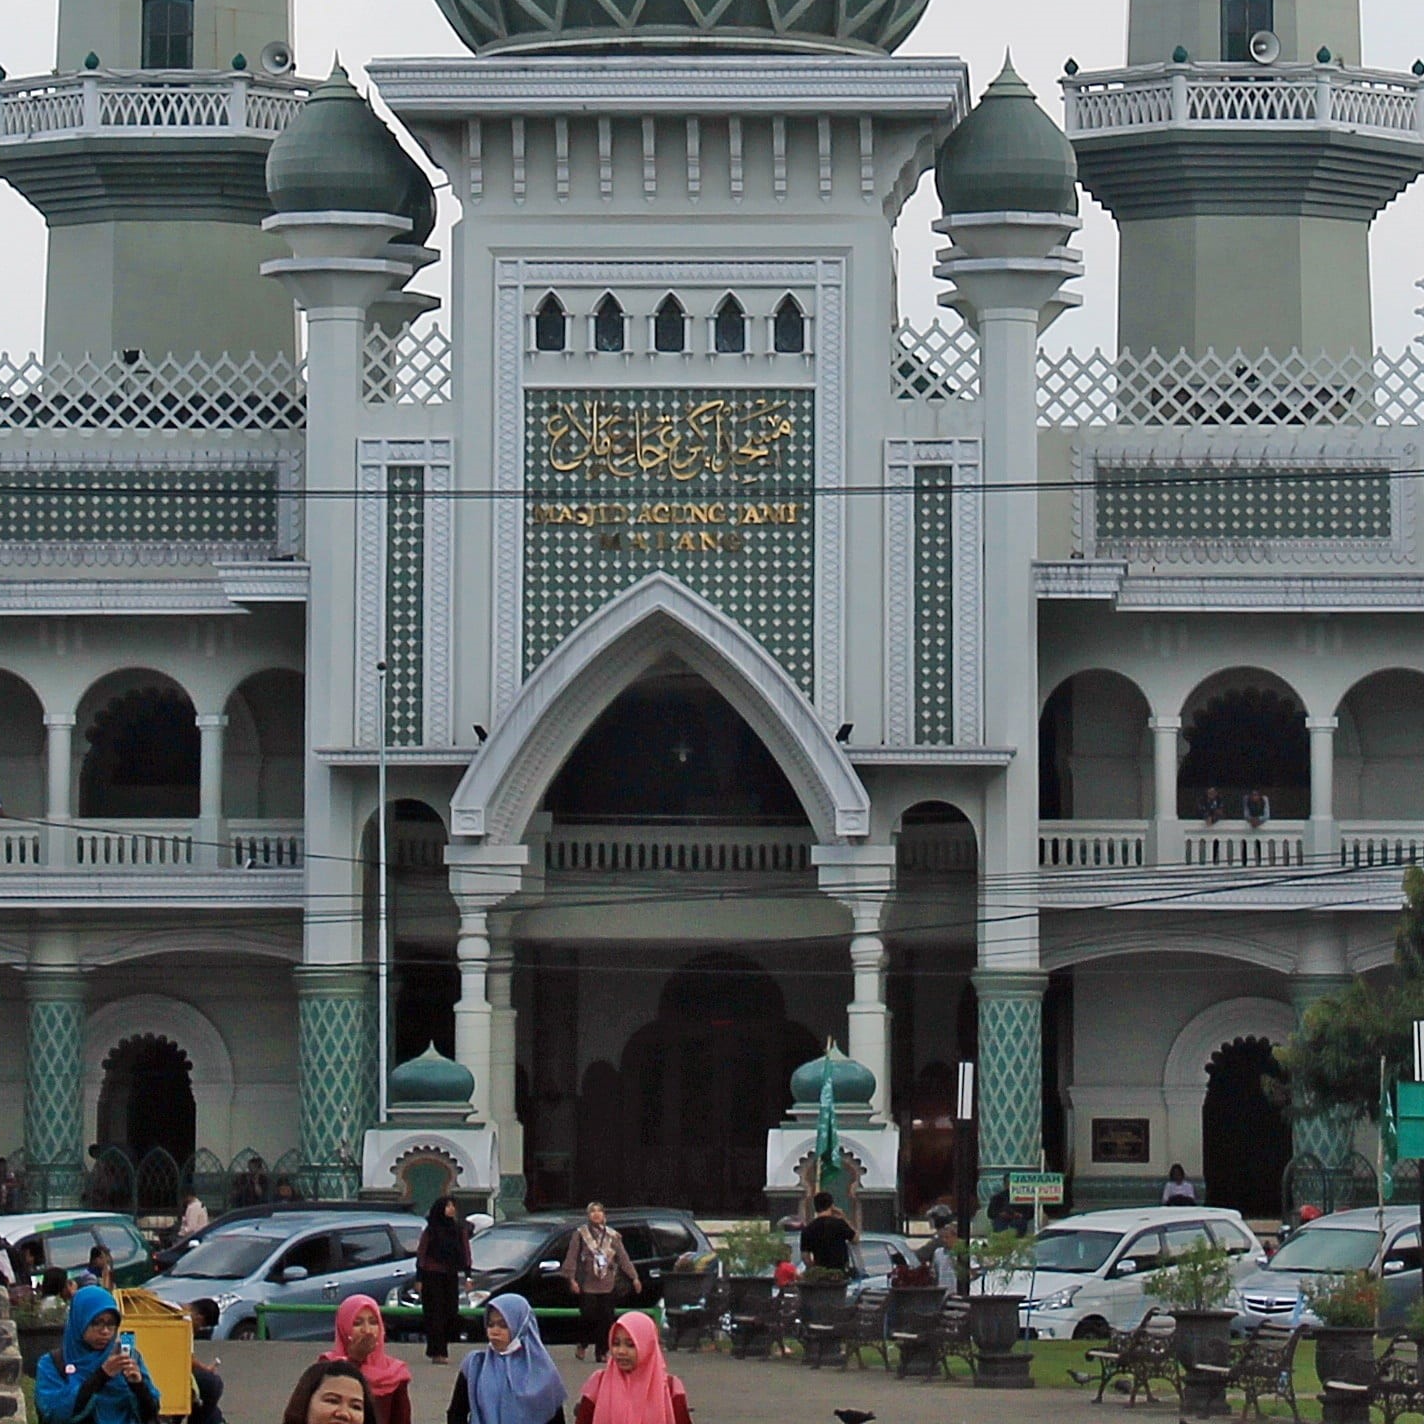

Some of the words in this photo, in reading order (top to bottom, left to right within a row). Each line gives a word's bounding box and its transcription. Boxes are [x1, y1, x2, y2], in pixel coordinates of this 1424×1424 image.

[533, 503, 626, 527] MASJID
[637, 503, 726, 524] AGUNG
[599, 531, 742, 552] MALANG
[1012, 1175, 1061, 1184] JAMAAH
